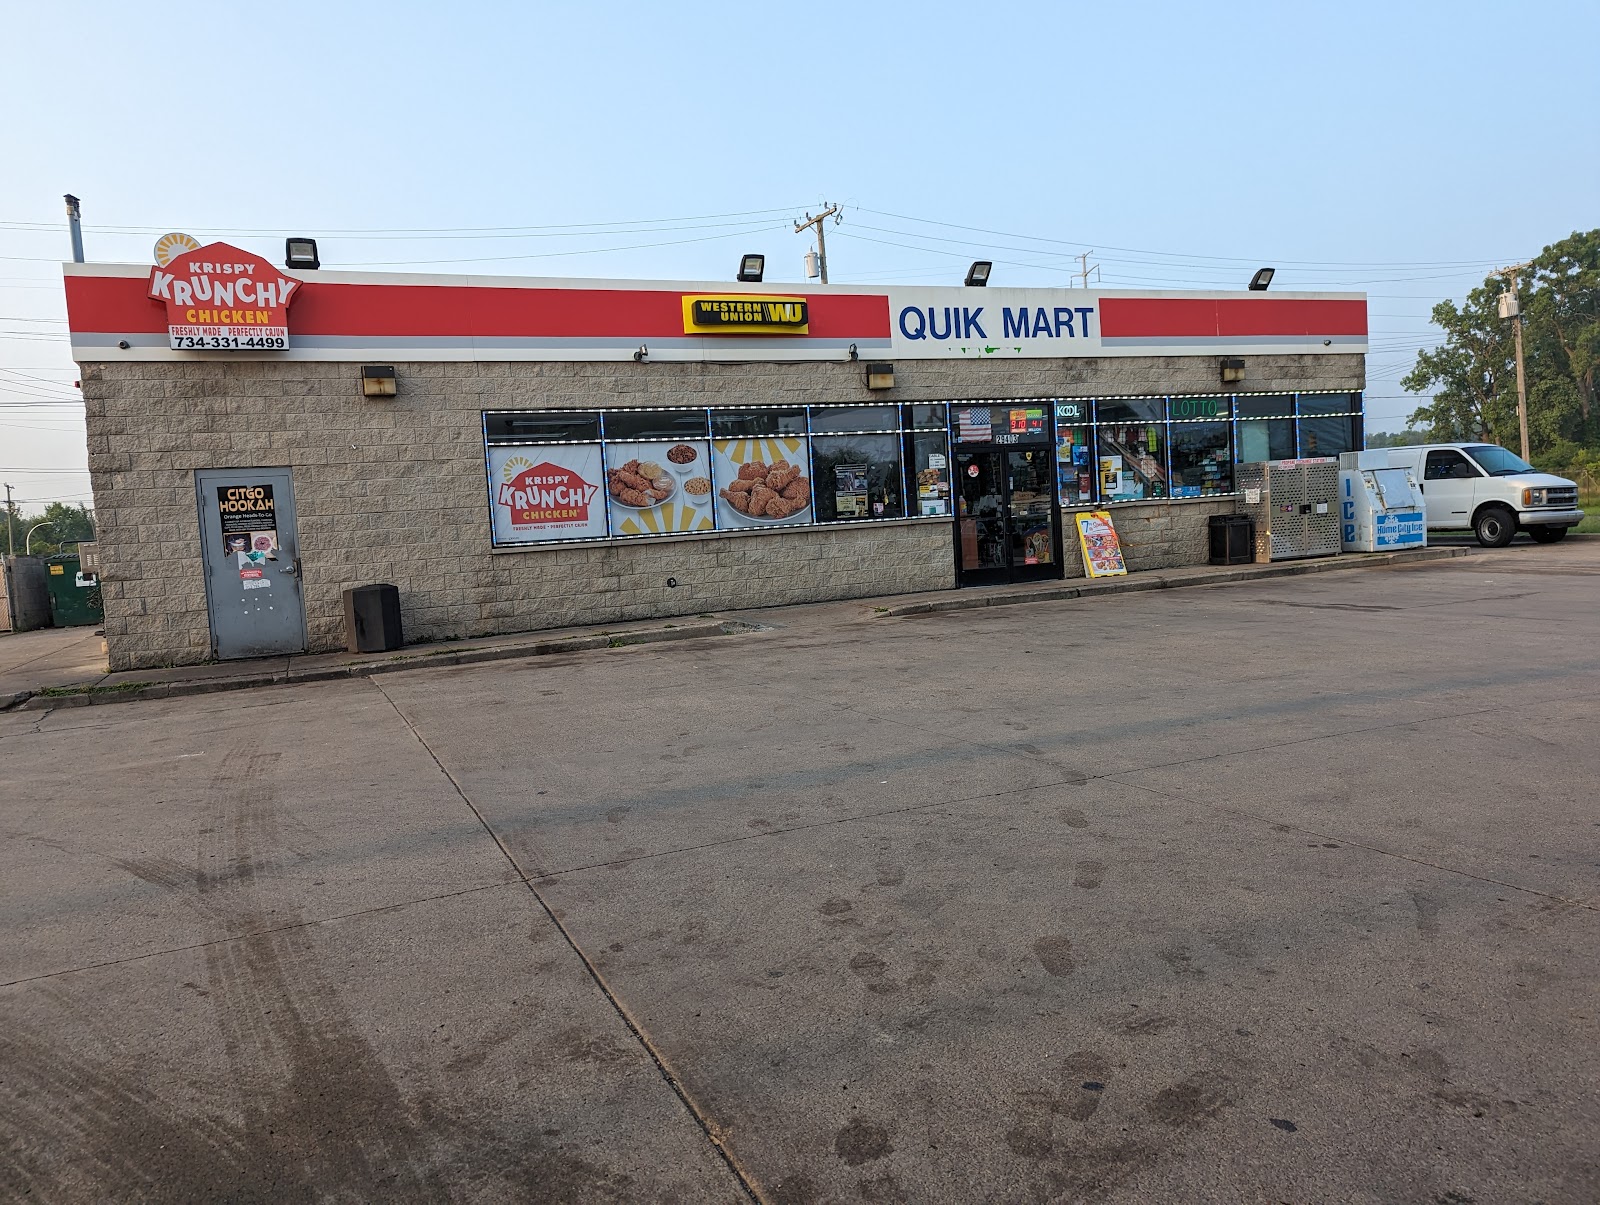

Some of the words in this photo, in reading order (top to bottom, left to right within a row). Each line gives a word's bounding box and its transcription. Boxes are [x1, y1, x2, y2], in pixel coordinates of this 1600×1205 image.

[189, 262, 256, 275] KRISPY
[151, 270, 297, 307] KRUNCHY
[186, 309, 270, 324] CHICKEN
[700, 302, 762, 312] WESTERN
[768, 303, 803, 322] WU
[720, 312, 762, 322] UNION
[899, 306, 988, 341] QUIK
[1002, 307, 1094, 338] MART
[171, 326, 201, 336] FRESHLY
[202, 327, 222, 336] MADE
[228, 327, 263, 337] PERFECTLY
[265, 328, 285, 337] CAJUN
[174, 336, 285, 348] 734-331-4499
[1056, 405, 1080, 417] KOOL
[1172, 400, 1217, 416] LOTTO
[525, 475, 569, 485] KRISPY
[227, 488, 264, 500] CITGO
[500, 484, 598, 510] KRUNCHY
[219, 499, 274, 512] HOOKAH
[522, 510, 578, 520] CHICKEN
[1377, 524, 1397, 535] Home
[1397, 523, 1411, 534] City
[1411, 523, 1423, 532] Ice
